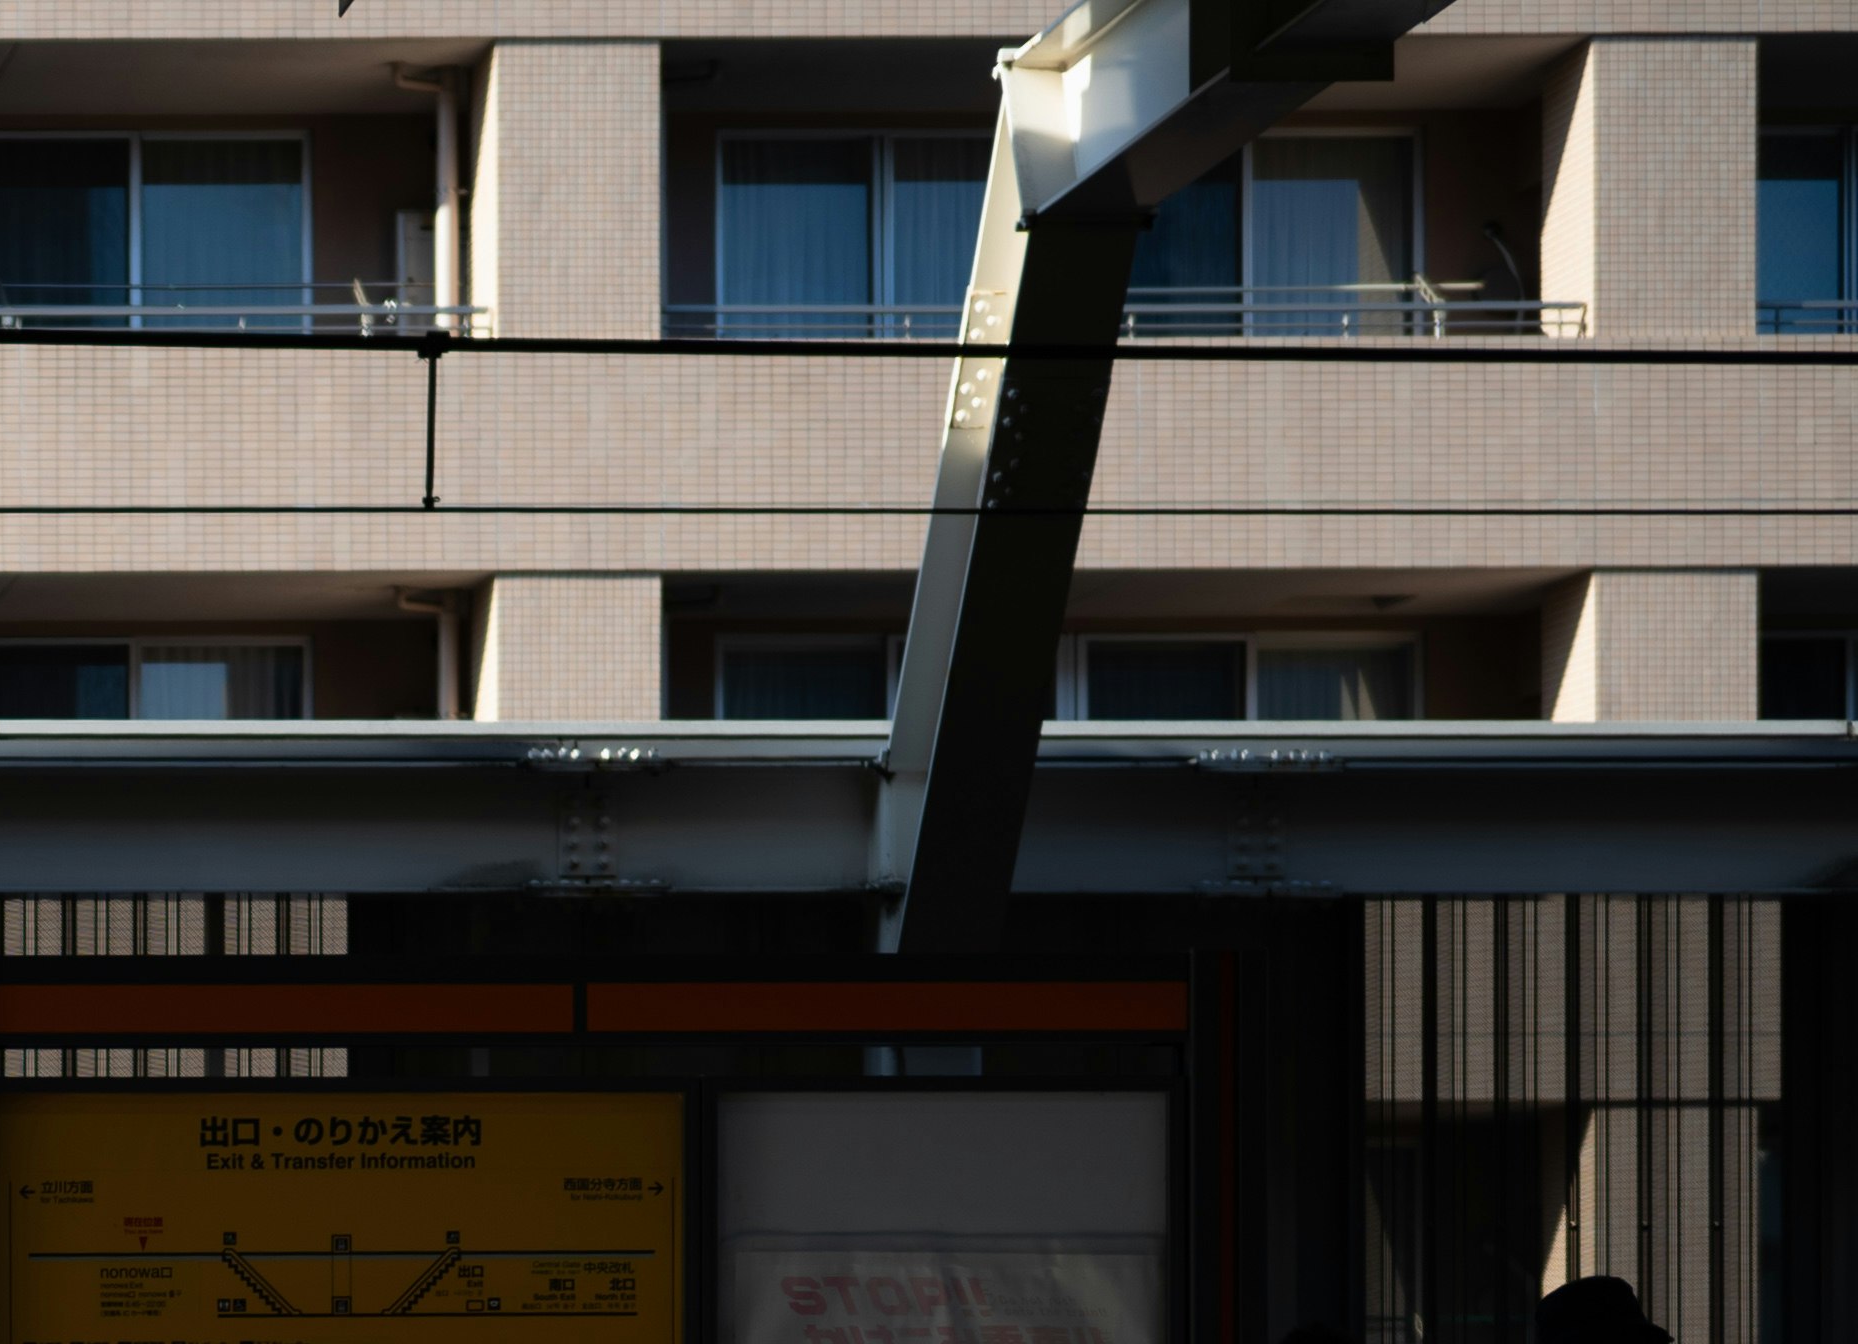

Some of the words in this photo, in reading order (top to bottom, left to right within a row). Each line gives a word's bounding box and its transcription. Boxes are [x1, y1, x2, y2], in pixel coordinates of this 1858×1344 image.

[200, 1116, 481, 1147] 出口・のりかえ案内
[207, 1153, 243, 1170] Exit
[251, 1153, 264, 1170] &
[271, 1153, 354, 1170] Transfer
[362, 1153, 475, 1170] Information
[41, 1181, 93, 1194] 立川方面
[564, 1178, 642, 1191] 西国分寺方面
[100, 1267, 172, 1279] nonowa口
[458, 1266, 483, 1278] 出口
[584, 1262, 634, 1274] 中央改札
